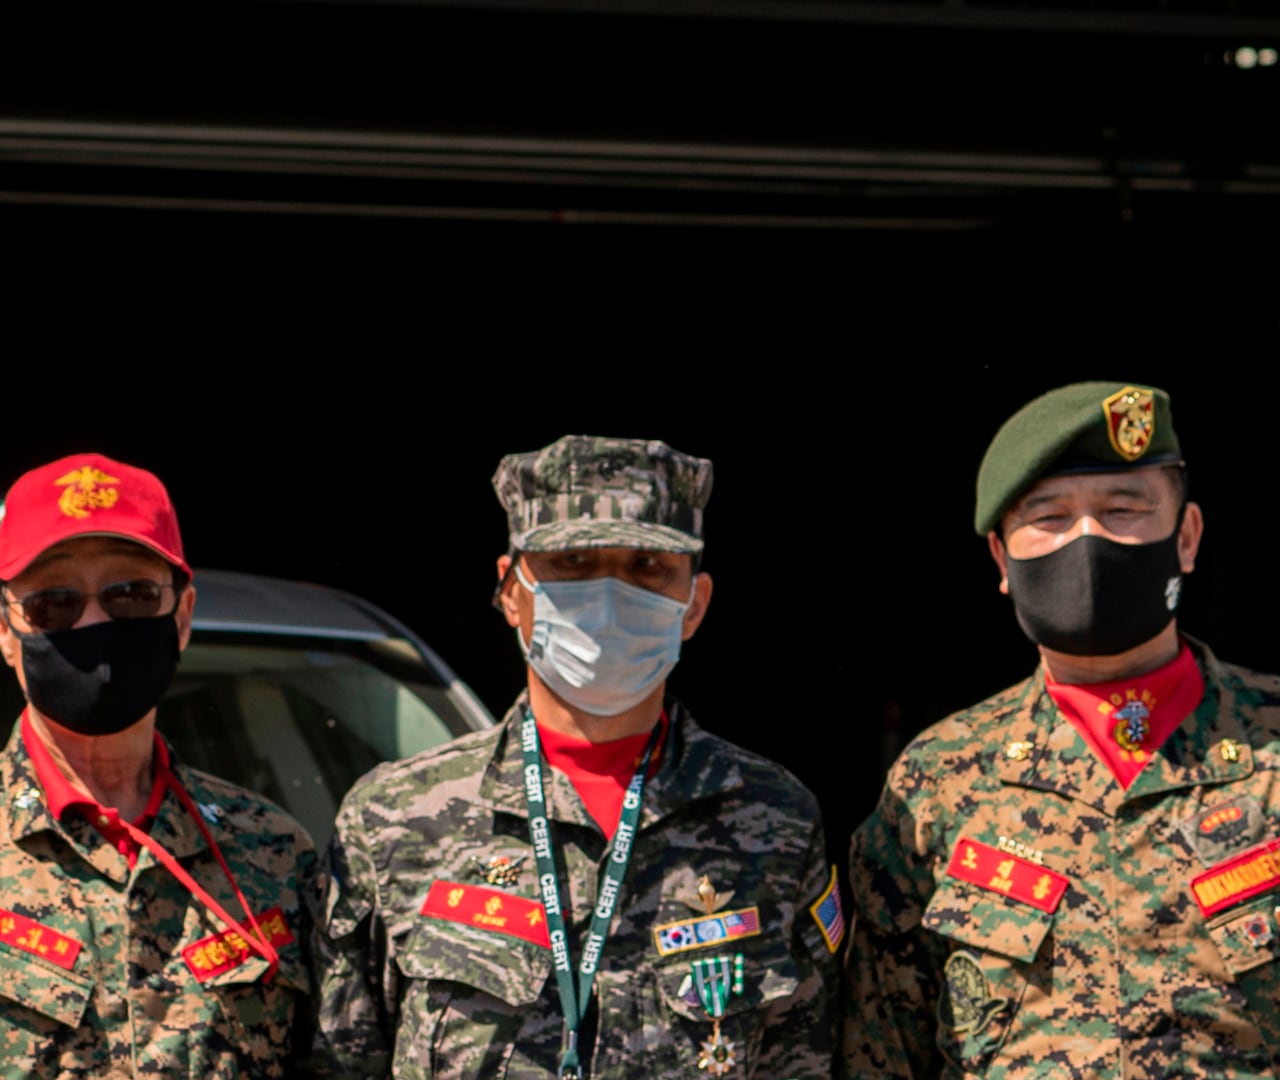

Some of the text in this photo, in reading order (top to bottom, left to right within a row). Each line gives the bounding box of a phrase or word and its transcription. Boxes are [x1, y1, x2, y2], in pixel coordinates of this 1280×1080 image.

[524, 764, 543, 804] CERT
[531, 816, 552, 859] CERT
[611, 821, 634, 864] CERT
[540, 872, 561, 916] CERT
[595, 875, 620, 919] CERT
[550, 929, 571, 973] CERT
[579, 931, 604, 975] CERT
